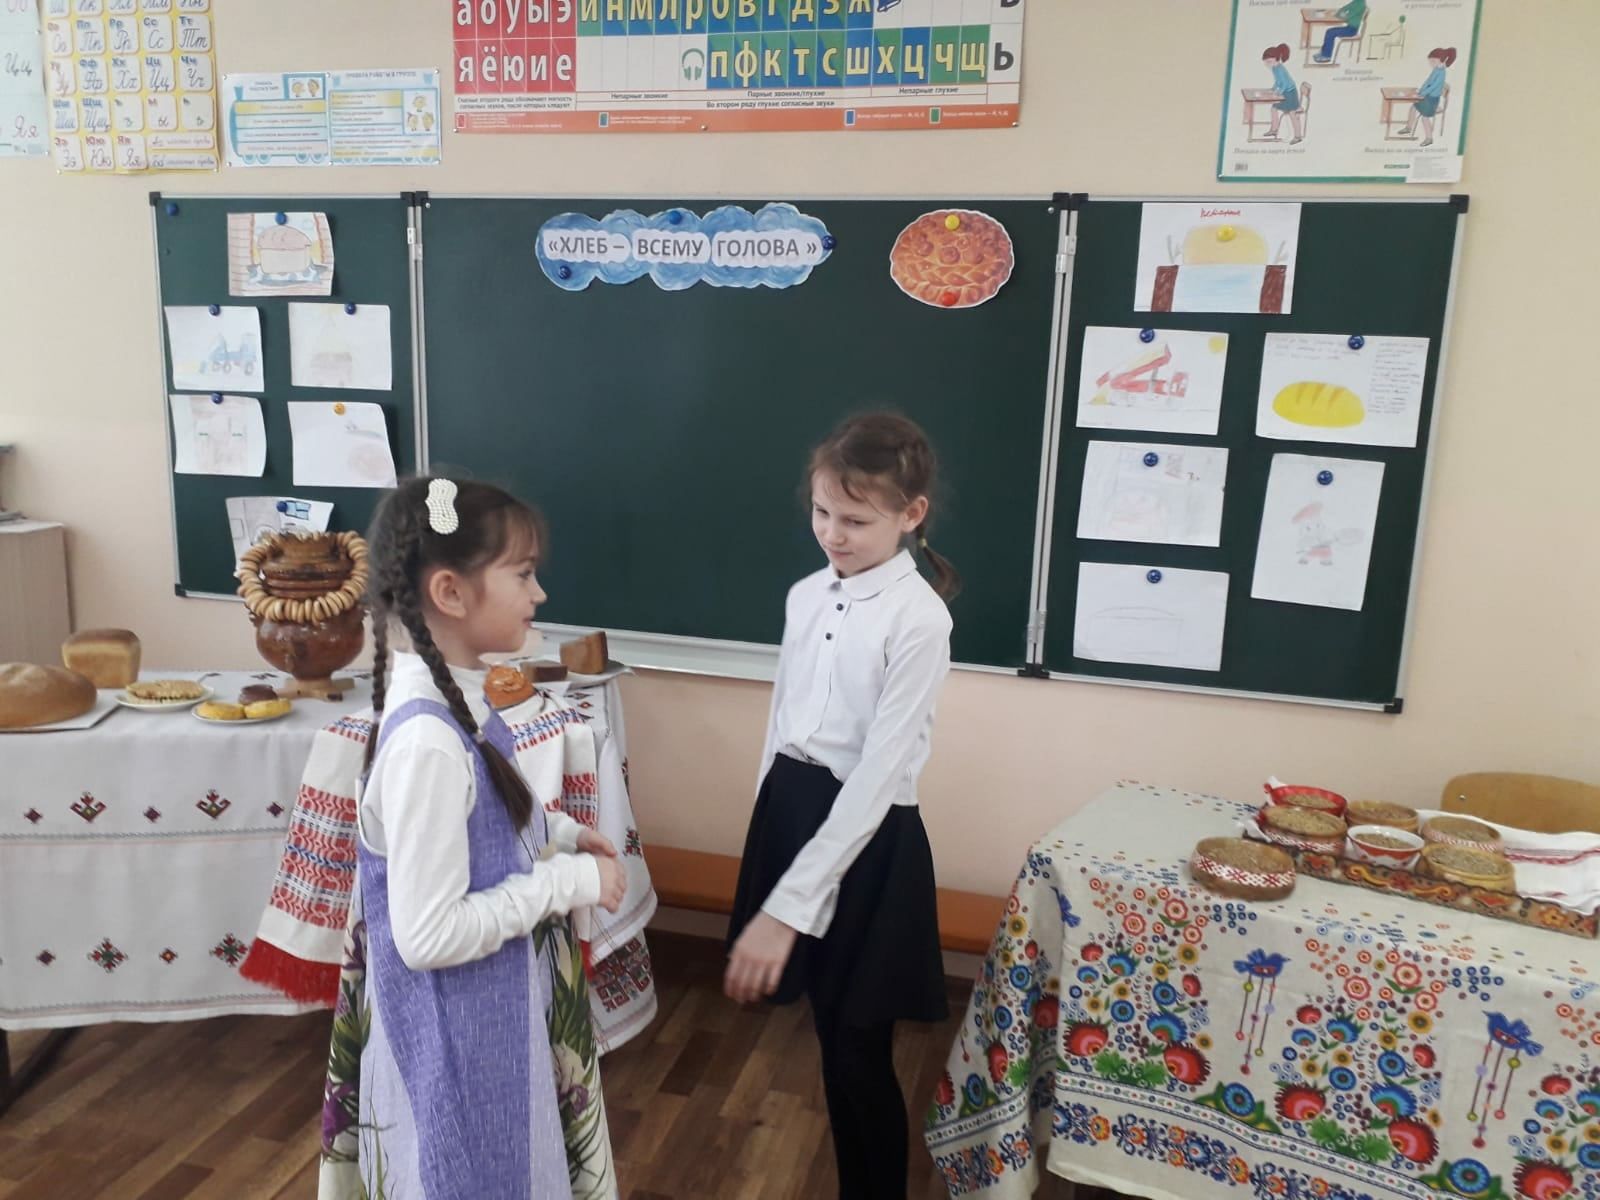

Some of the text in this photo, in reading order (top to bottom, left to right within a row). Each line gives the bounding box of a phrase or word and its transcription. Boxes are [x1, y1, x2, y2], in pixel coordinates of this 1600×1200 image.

[481, 0, 496, 25] о
[504, 0, 521, 34] у
[527, 0, 550, 23] ы
[556, 0, 571, 23] э
[459, 46, 572, 82] я ё ю и е
[711, 51, 728, 78] п
[734, 41, 758, 88] ф
[764, 49, 781, 76] к
[793, 49, 810, 75] т
[822, 47, 837, 75] с
[846, 47, 869, 75] ш
[877, 46, 895, 73] х
[904, 45, 925, 80] ц
[935, 43, 953, 72] ч
[961, 42, 986, 78] щ
[637, 238, 704, 258] ВСЕМУ
